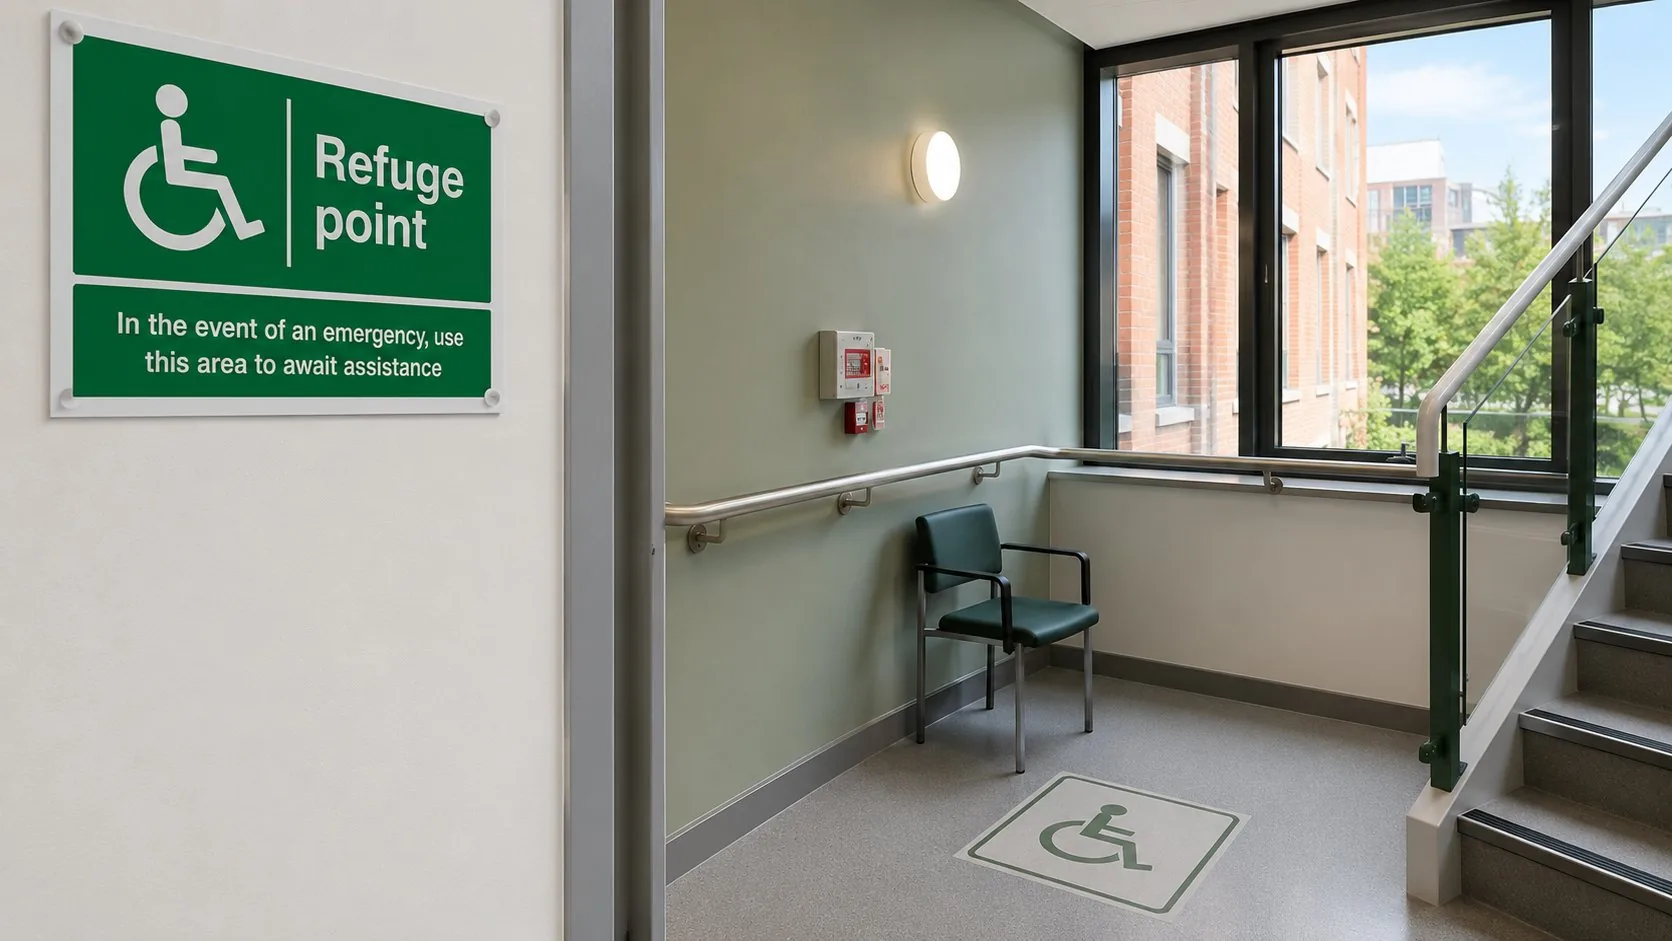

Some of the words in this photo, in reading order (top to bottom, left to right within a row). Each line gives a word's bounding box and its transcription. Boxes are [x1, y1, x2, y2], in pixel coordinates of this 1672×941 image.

[316, 133, 464, 206] Refuge
[316, 201, 427, 251] point
[117, 311, 140, 335] In
[147, 312, 188, 337] the
[194, 318, 258, 339] event
[264, 318, 286, 340] of
[291, 324, 317, 341] an
[322, 326, 429, 350] emergency,
[434, 331, 464, 347] use
[144, 350, 190, 374] this
[197, 356, 248, 374] area
[253, 354, 277, 375] to
[283, 354, 338, 376] await
[343, 356, 442, 377] assistance
